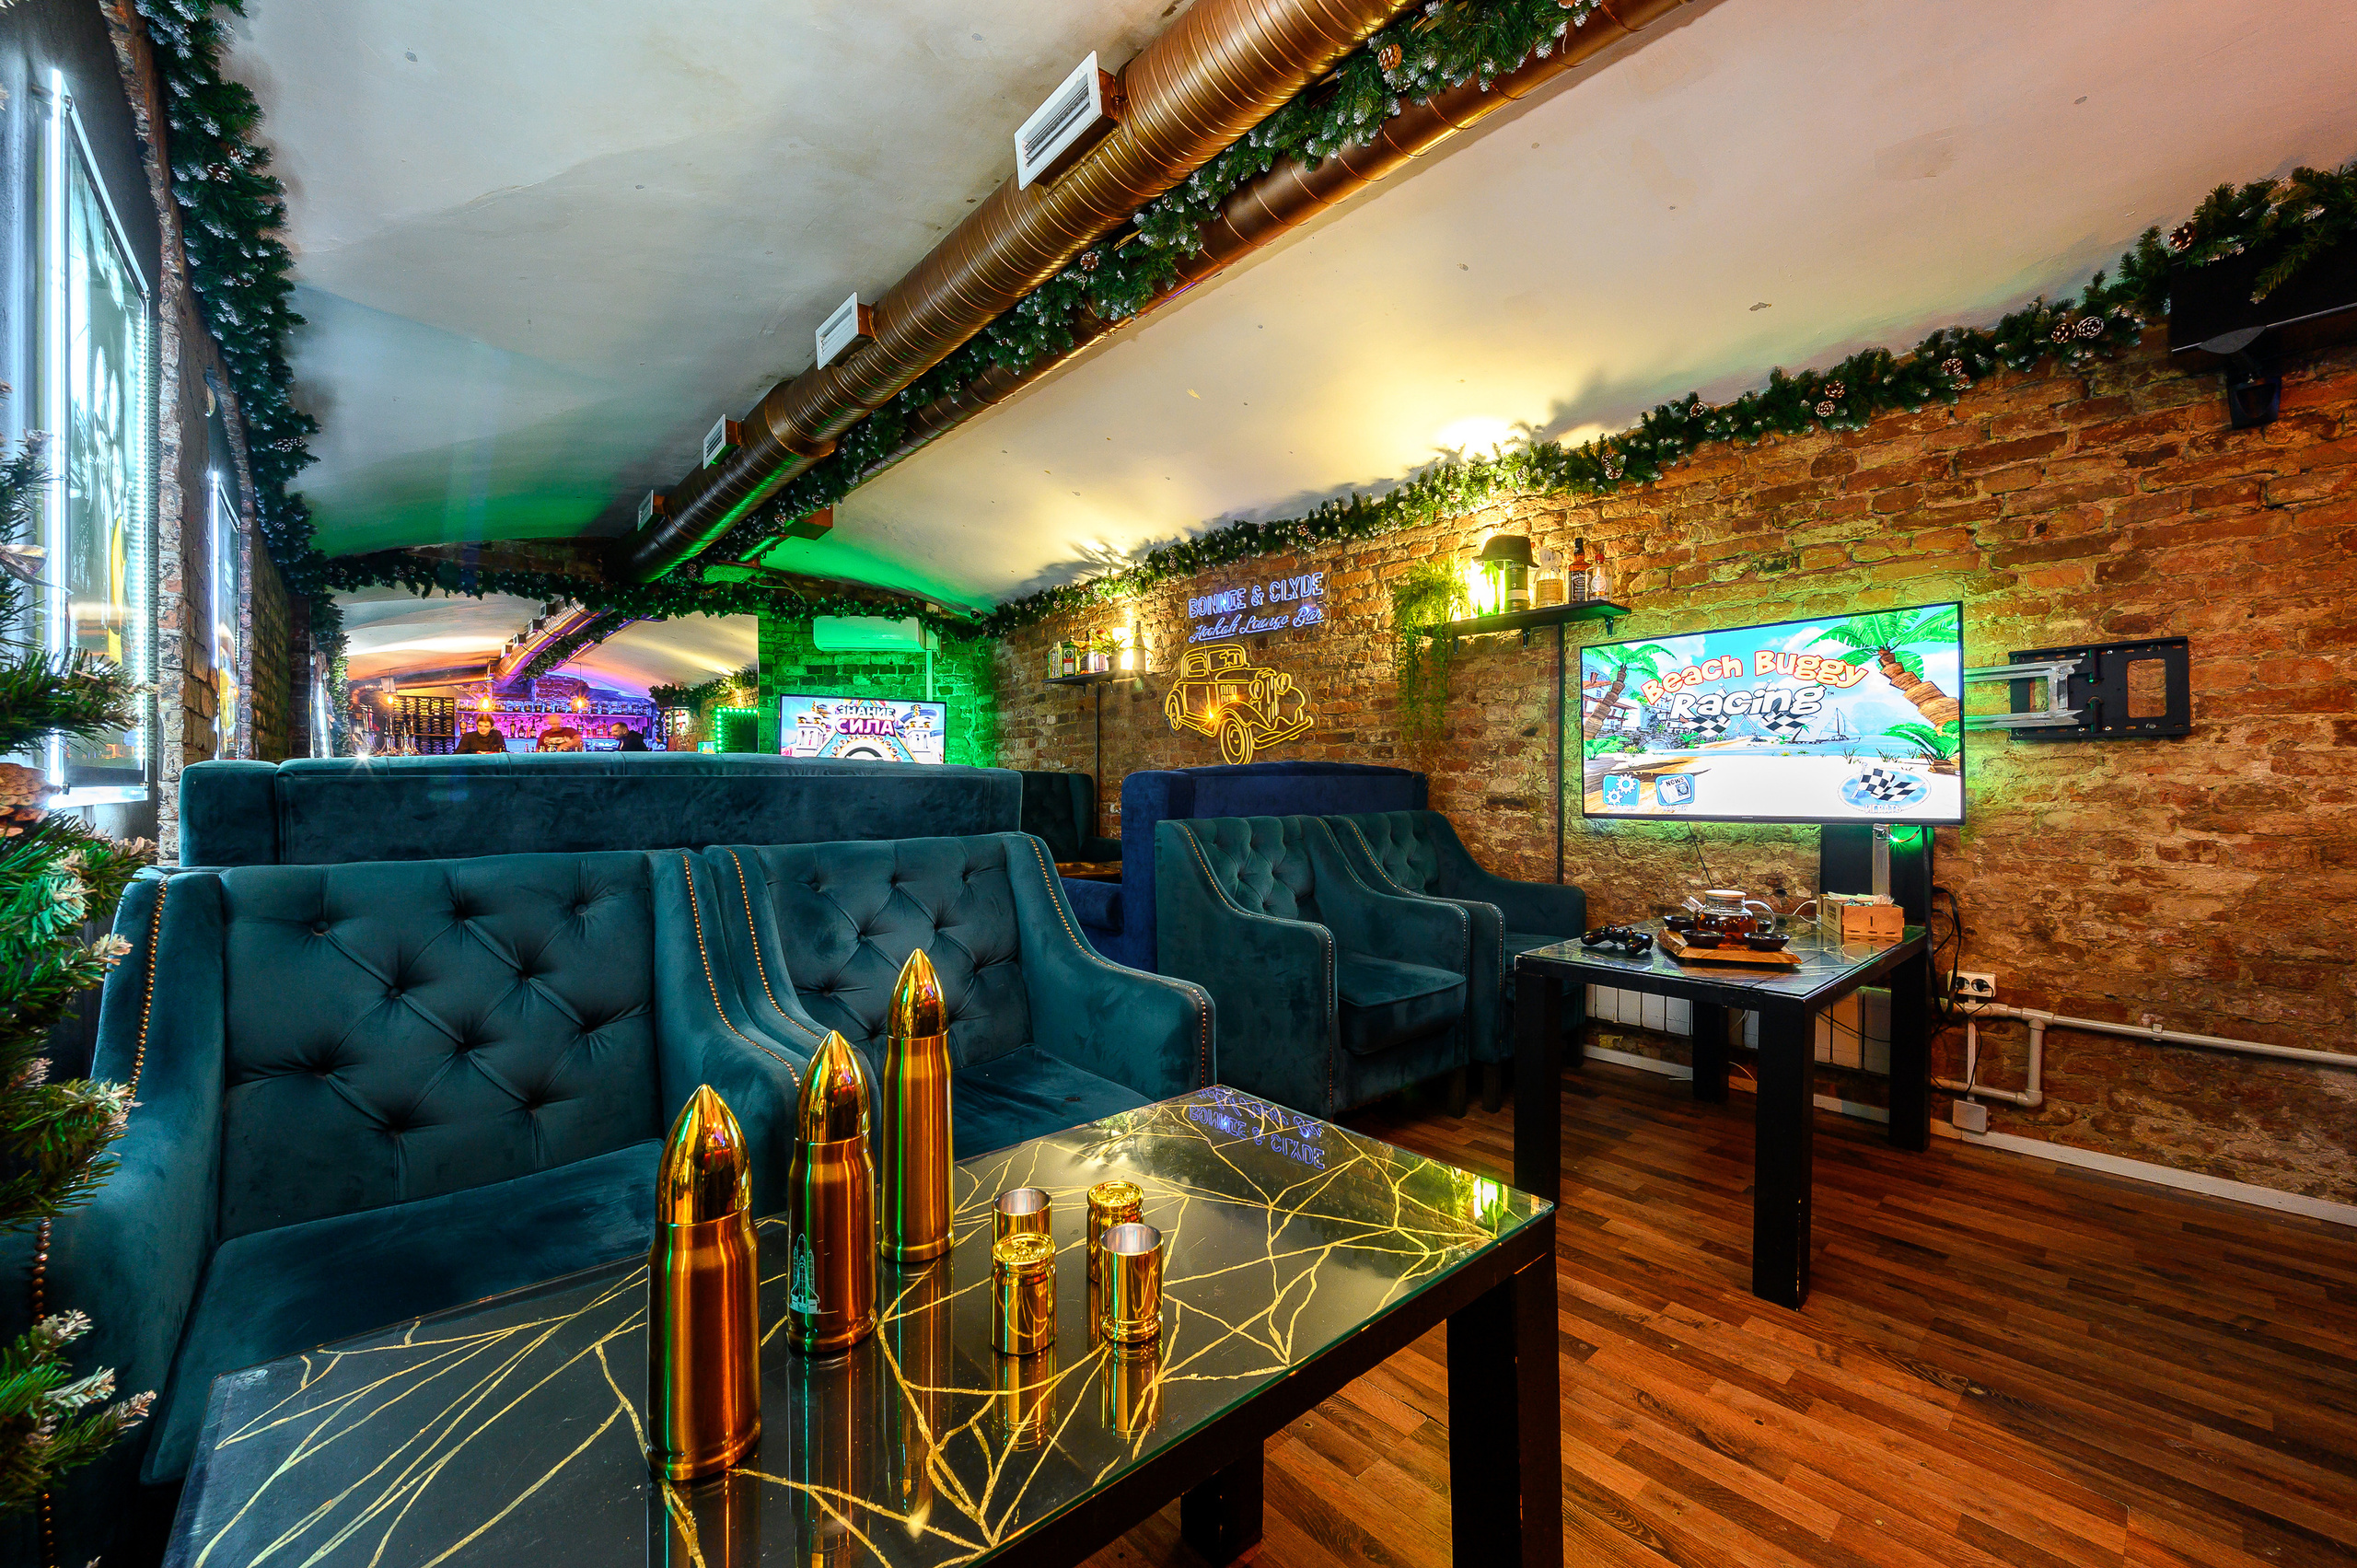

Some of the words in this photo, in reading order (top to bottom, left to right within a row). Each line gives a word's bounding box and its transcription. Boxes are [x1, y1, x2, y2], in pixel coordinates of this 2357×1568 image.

[1189, 587, 1247, 619] BONNIE
[1250, 585, 1264, 607] &
[1269, 572, 1324, 603] CLYDE
[1189, 614, 1243, 644] Hookah
[1239, 615, 1289, 634] Lounge
[1293, 606, 1325, 628] Bar
[1641, 655, 1744, 705] Beach
[1754, 650, 1870, 689] Buggy
[836, 705, 896, 717] ЗНАНИЕ
[1670, 685, 1828, 720] Racing
[835, 718, 897, 736] СИЛА
[1864, 804, 1902, 814] ИГРАТЬ
